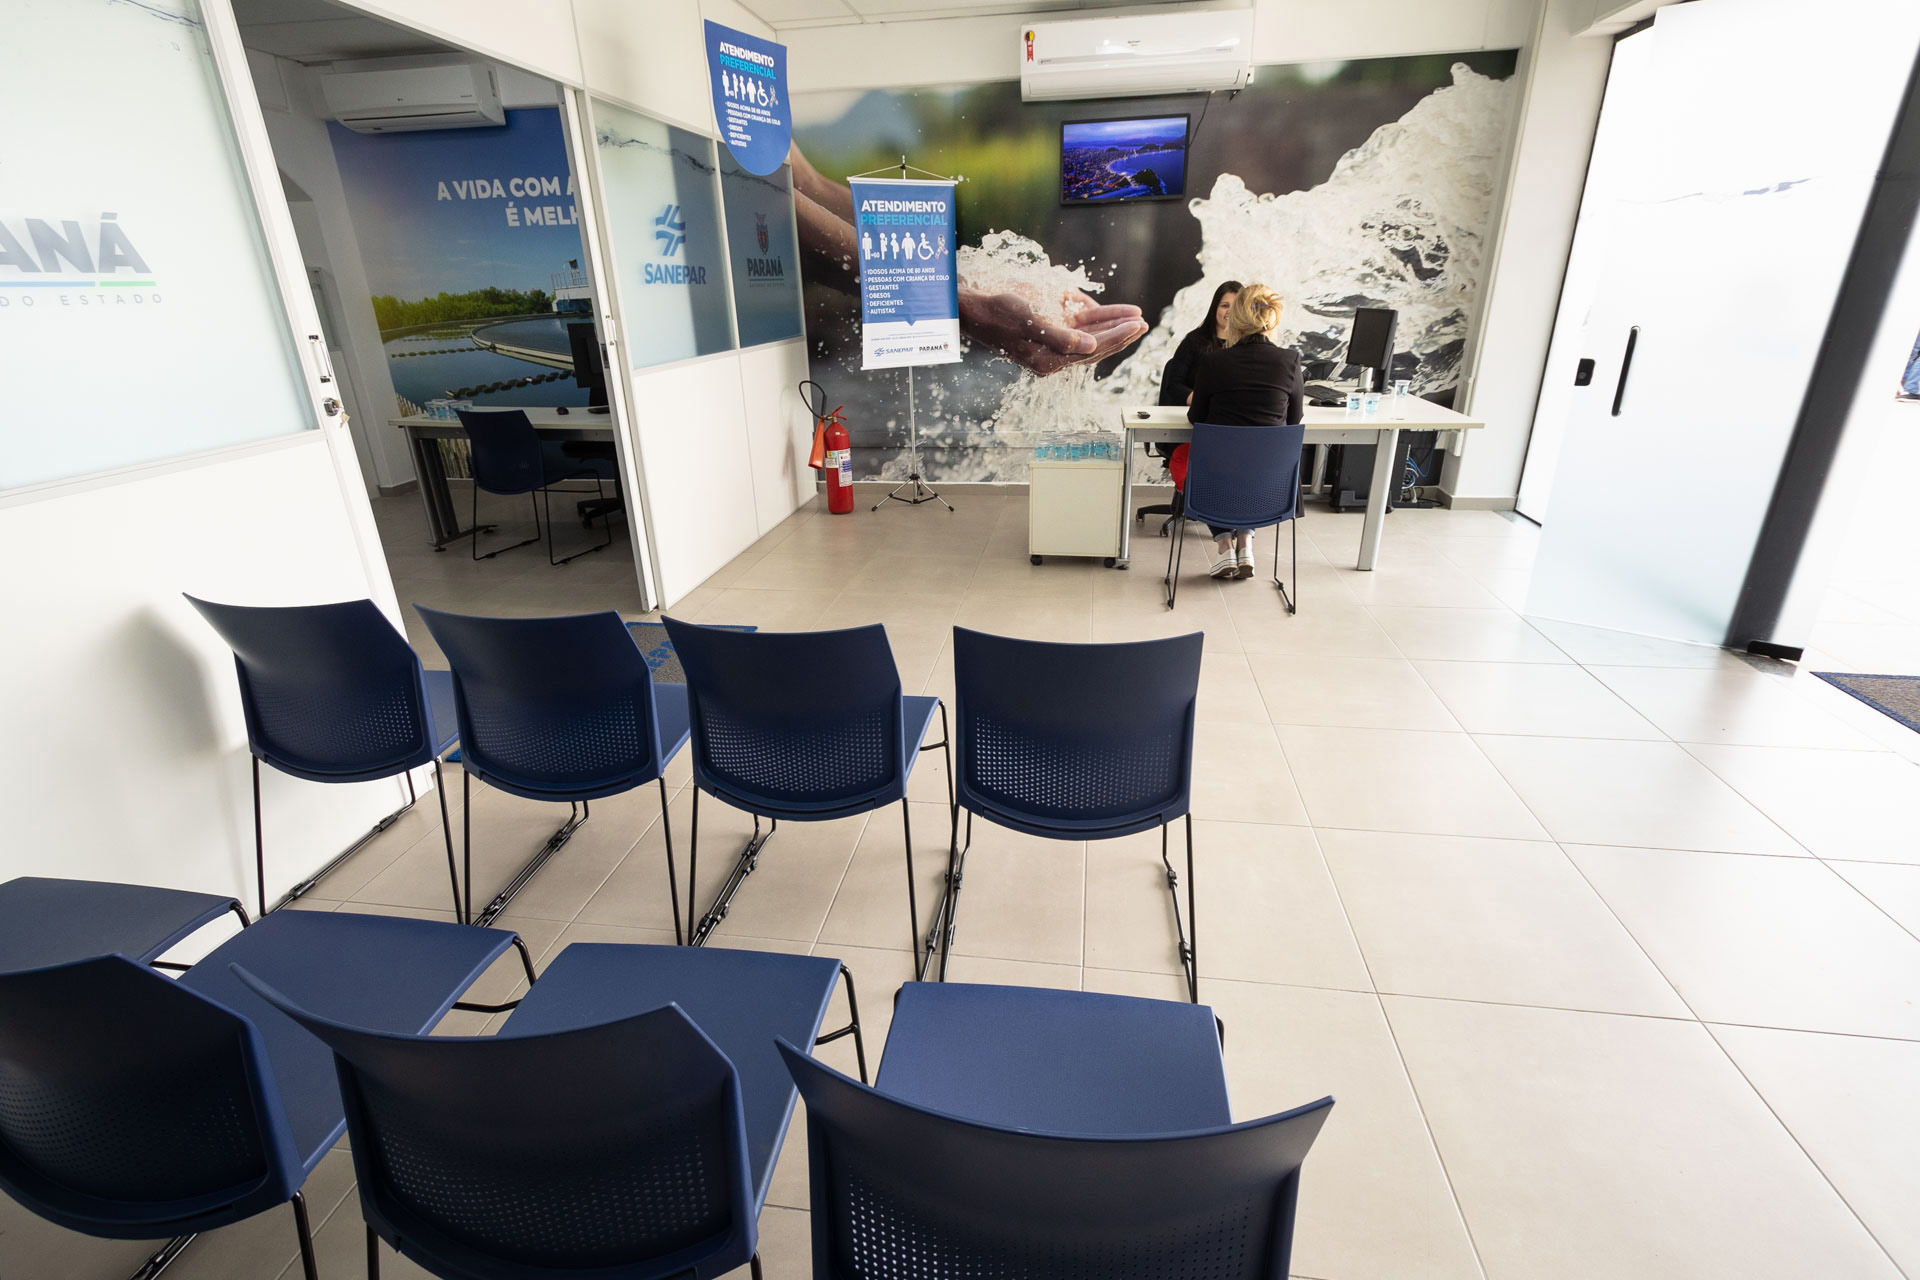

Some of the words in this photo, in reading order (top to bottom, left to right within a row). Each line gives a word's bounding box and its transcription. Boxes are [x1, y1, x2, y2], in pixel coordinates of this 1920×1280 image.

[720, 41, 774, 68] ATENDIMENTO
[720, 53, 777, 80] PREFERENCIAL
[438, 181, 452, 201] A
[453, 179, 506, 200] VIDA
[509, 176, 561, 197] COM
[505, 201, 520, 227] É
[861, 199, 946, 213] ATENDIMENTO
[860, 213, 948, 226] PREFERENCIAL
[644, 262, 707, 285] SANEPAR
[746, 255, 784, 277] PARANÁ
[889, 267, 906, 275] ACIMA
[906, 275, 928, 283] CRIANÇA
[60, 293, 162, 306] ESTADO
